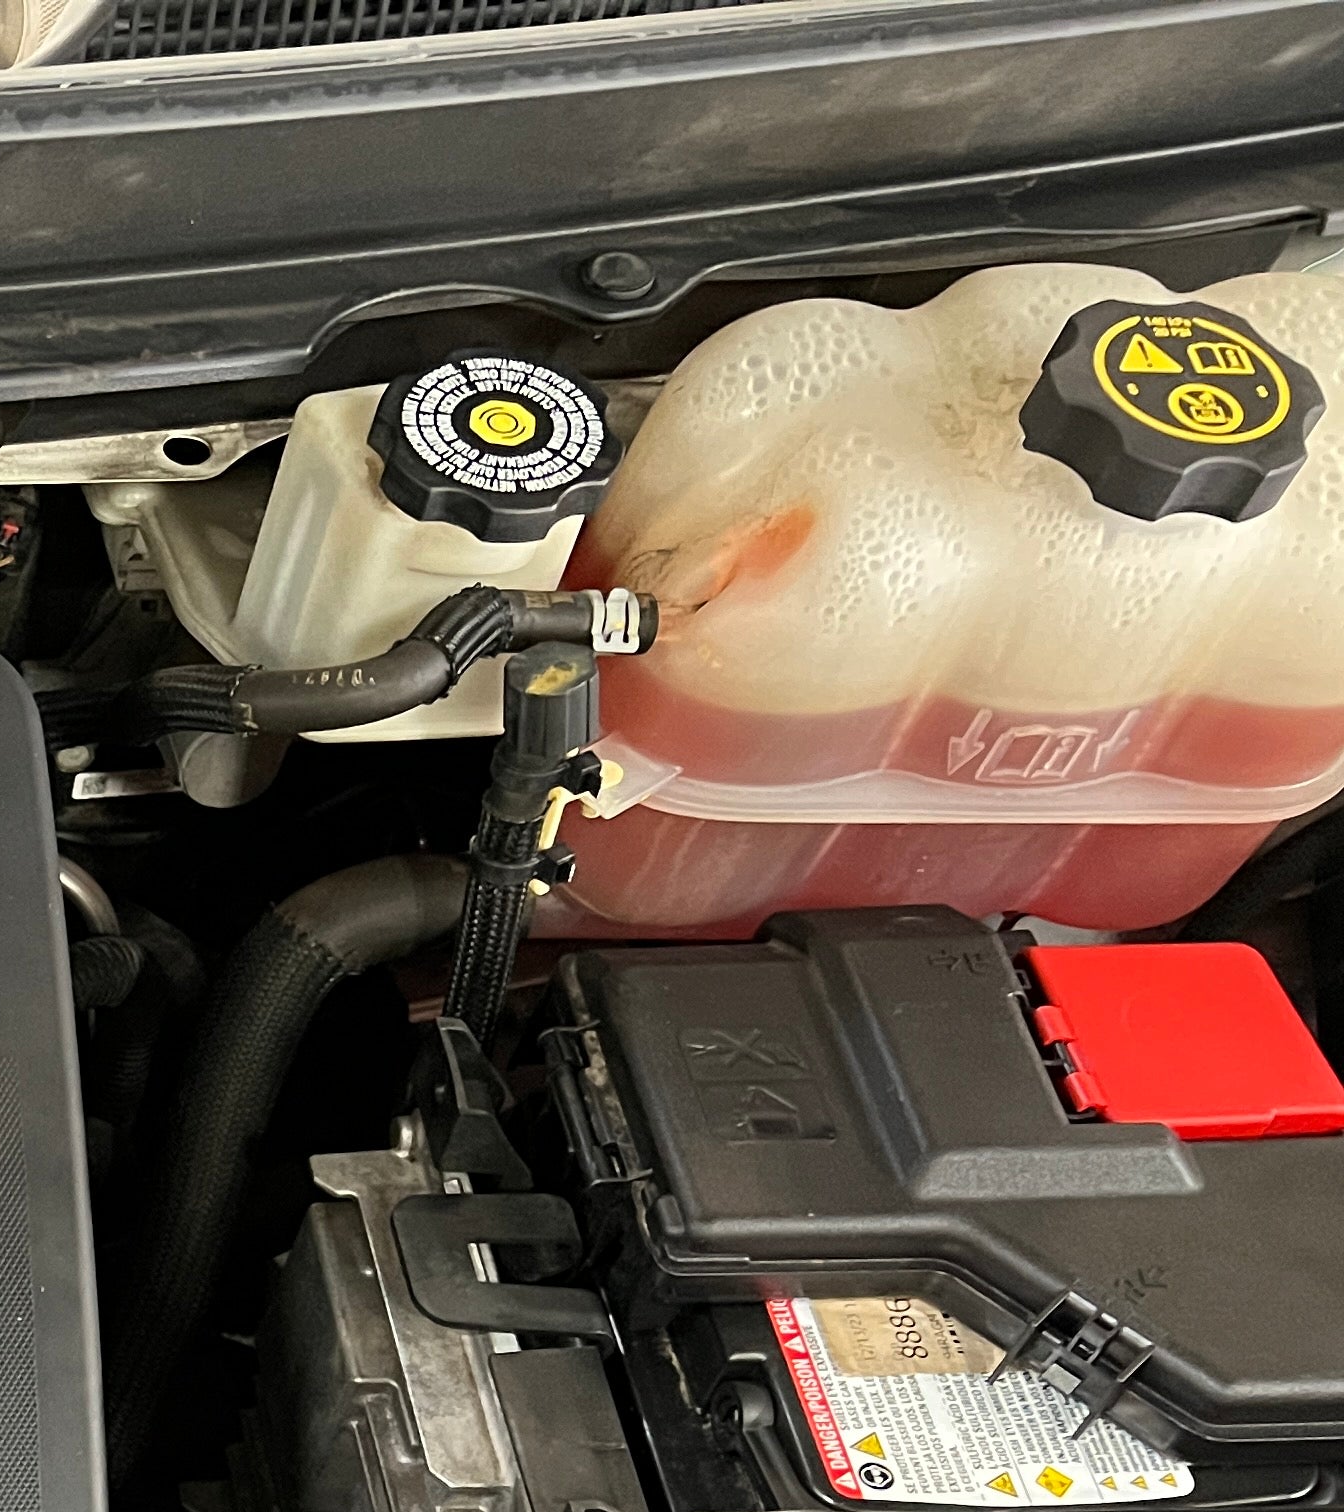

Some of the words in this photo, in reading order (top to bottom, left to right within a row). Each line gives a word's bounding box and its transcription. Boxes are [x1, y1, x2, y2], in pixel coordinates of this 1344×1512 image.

[885, 1297, 929, 1357] 8886
[836, 1380, 851, 1397] CAN
[863, 1377, 876, 1386] LE
[905, 1374, 924, 1401] CAUSA
[895, 1387, 912, 1403] LOS
[939, 1385, 957, 1401] CAN
[791, 1358, 849, 1468] DANGER/POISON
[843, 1399, 864, 1429] GASES
[947, 1403, 967, 1424] ACID
[950, 1379, 985, 1432] SULFURIQUE
[878, 1416, 894, 1431] LES
[914, 1434, 930, 1450] LOS
[956, 1426, 986, 1468] SULFURIC
